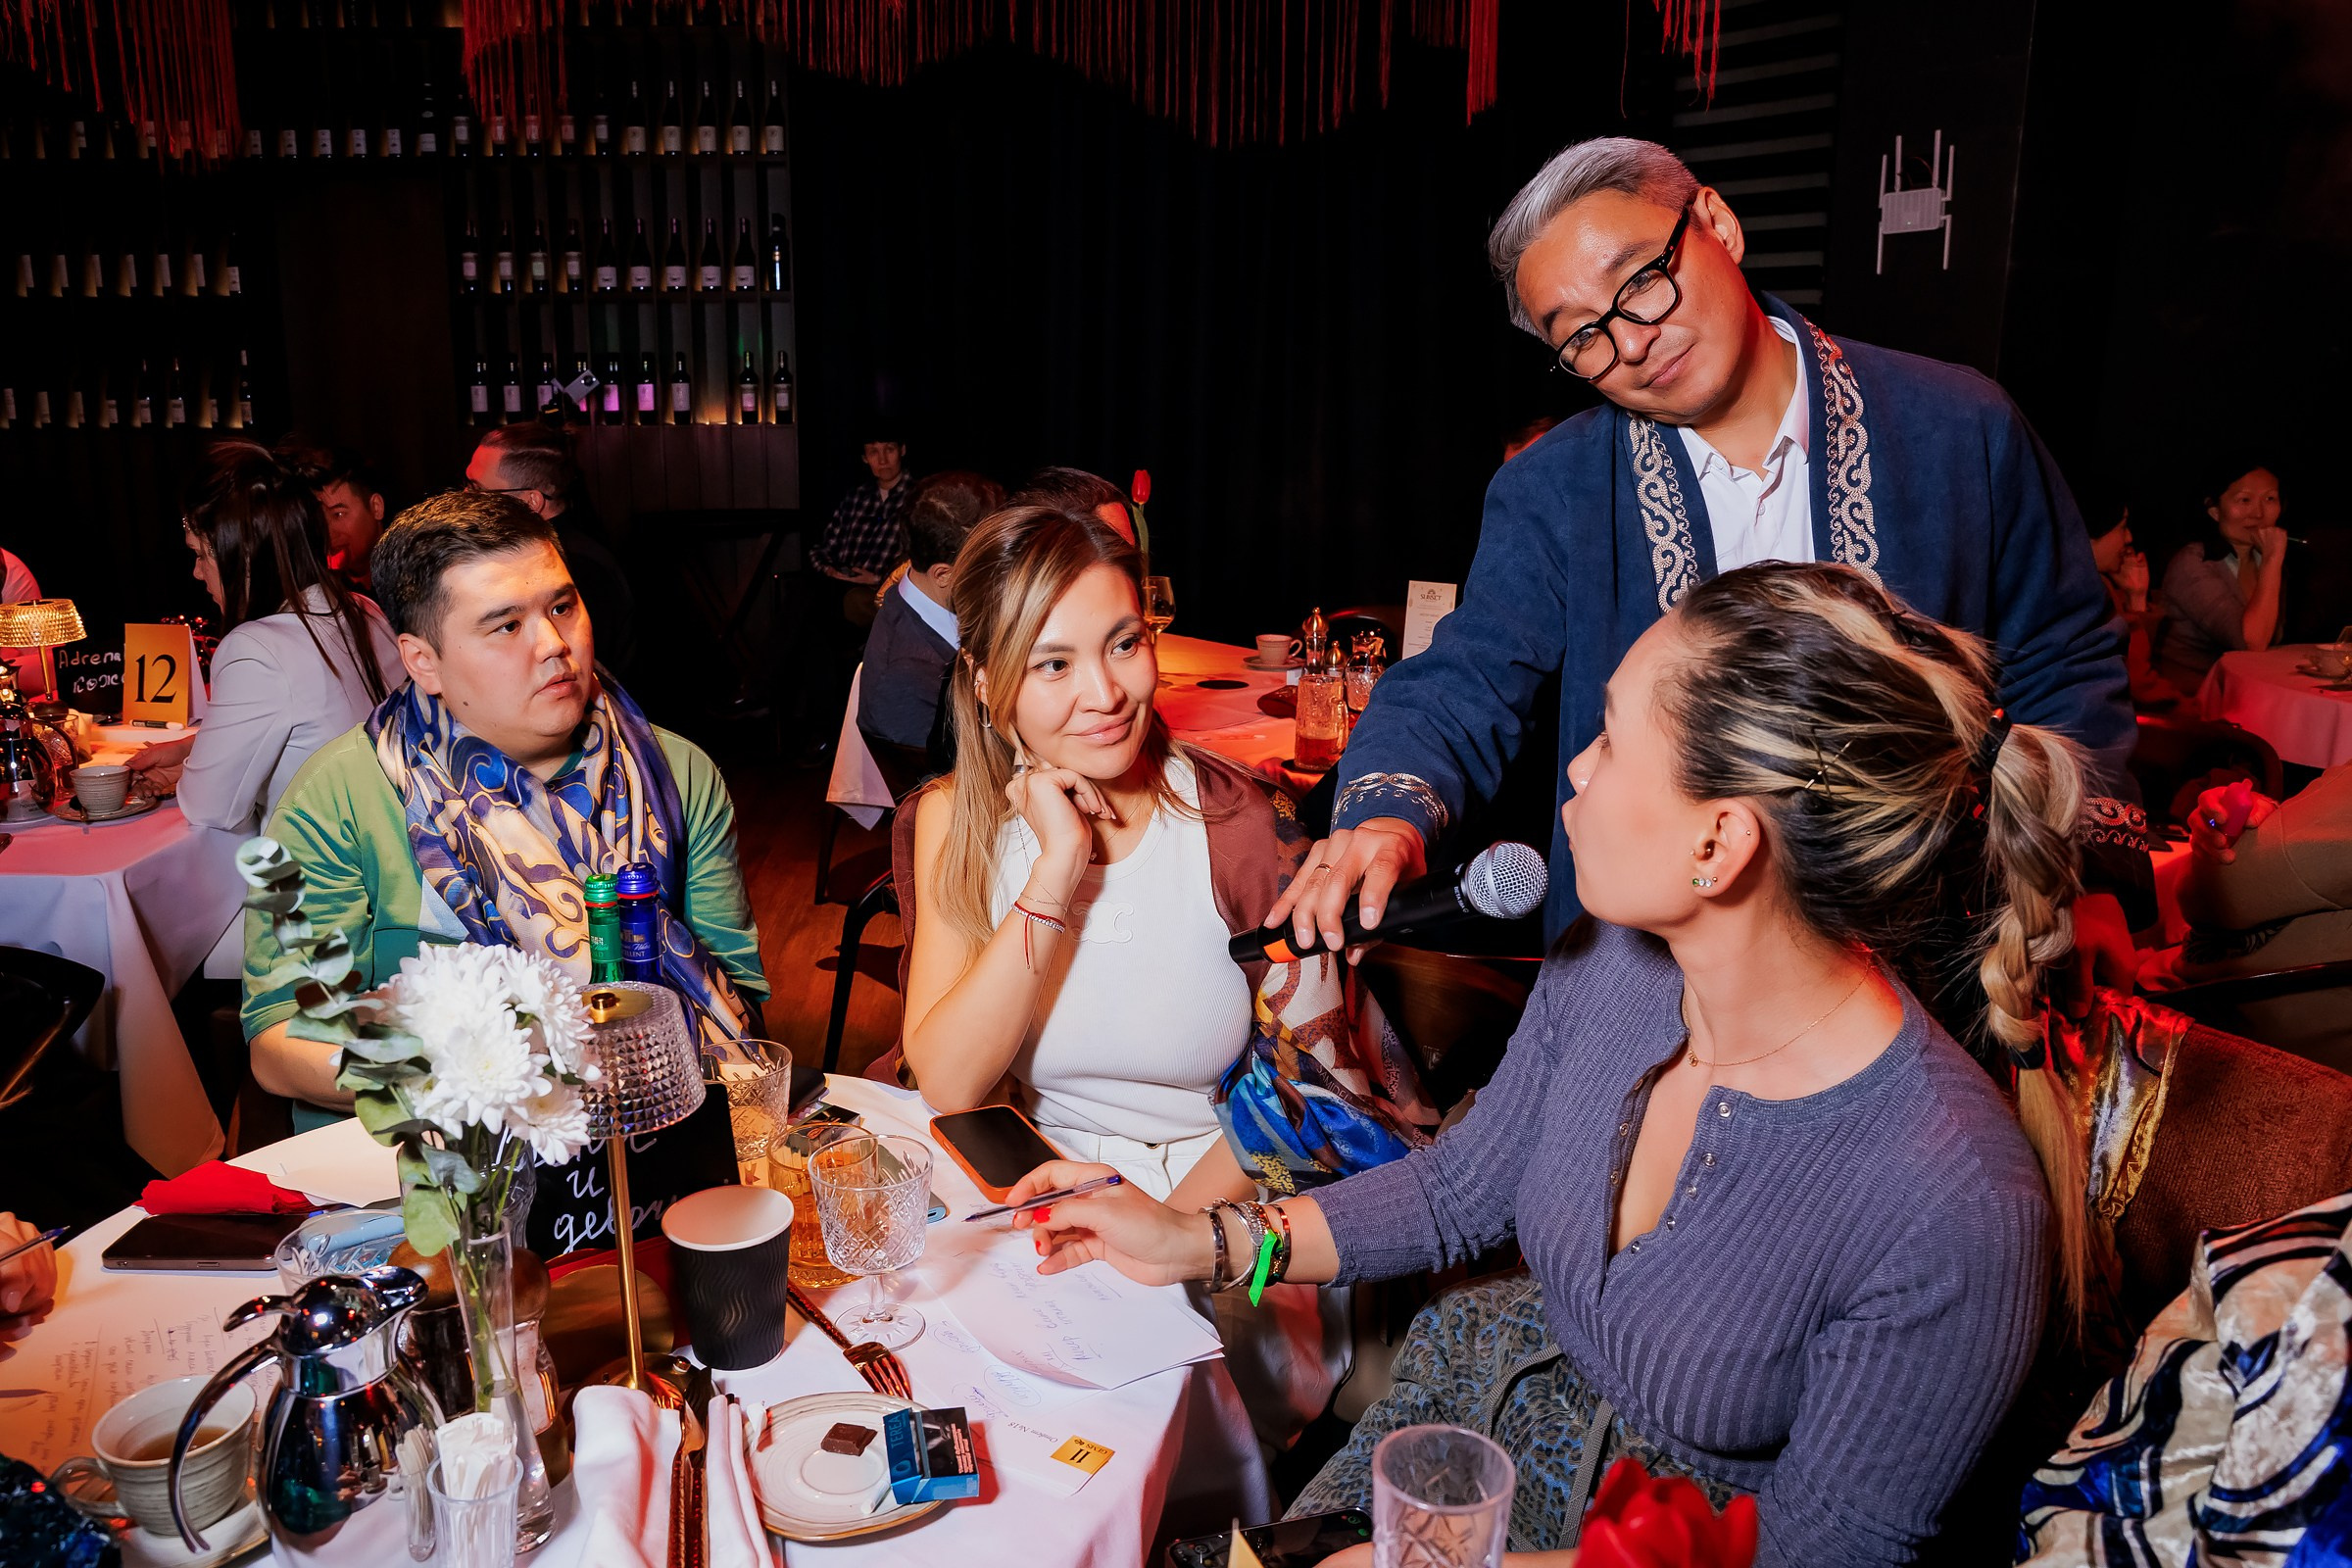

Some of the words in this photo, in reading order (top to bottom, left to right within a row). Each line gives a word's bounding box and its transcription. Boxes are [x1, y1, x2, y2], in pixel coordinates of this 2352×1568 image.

[59, 650, 125, 668] Adrena
[134, 654, 177, 704] 12
[888, 1414, 904, 1449] TEREA
[1069, 1448, 1091, 1464] 11
